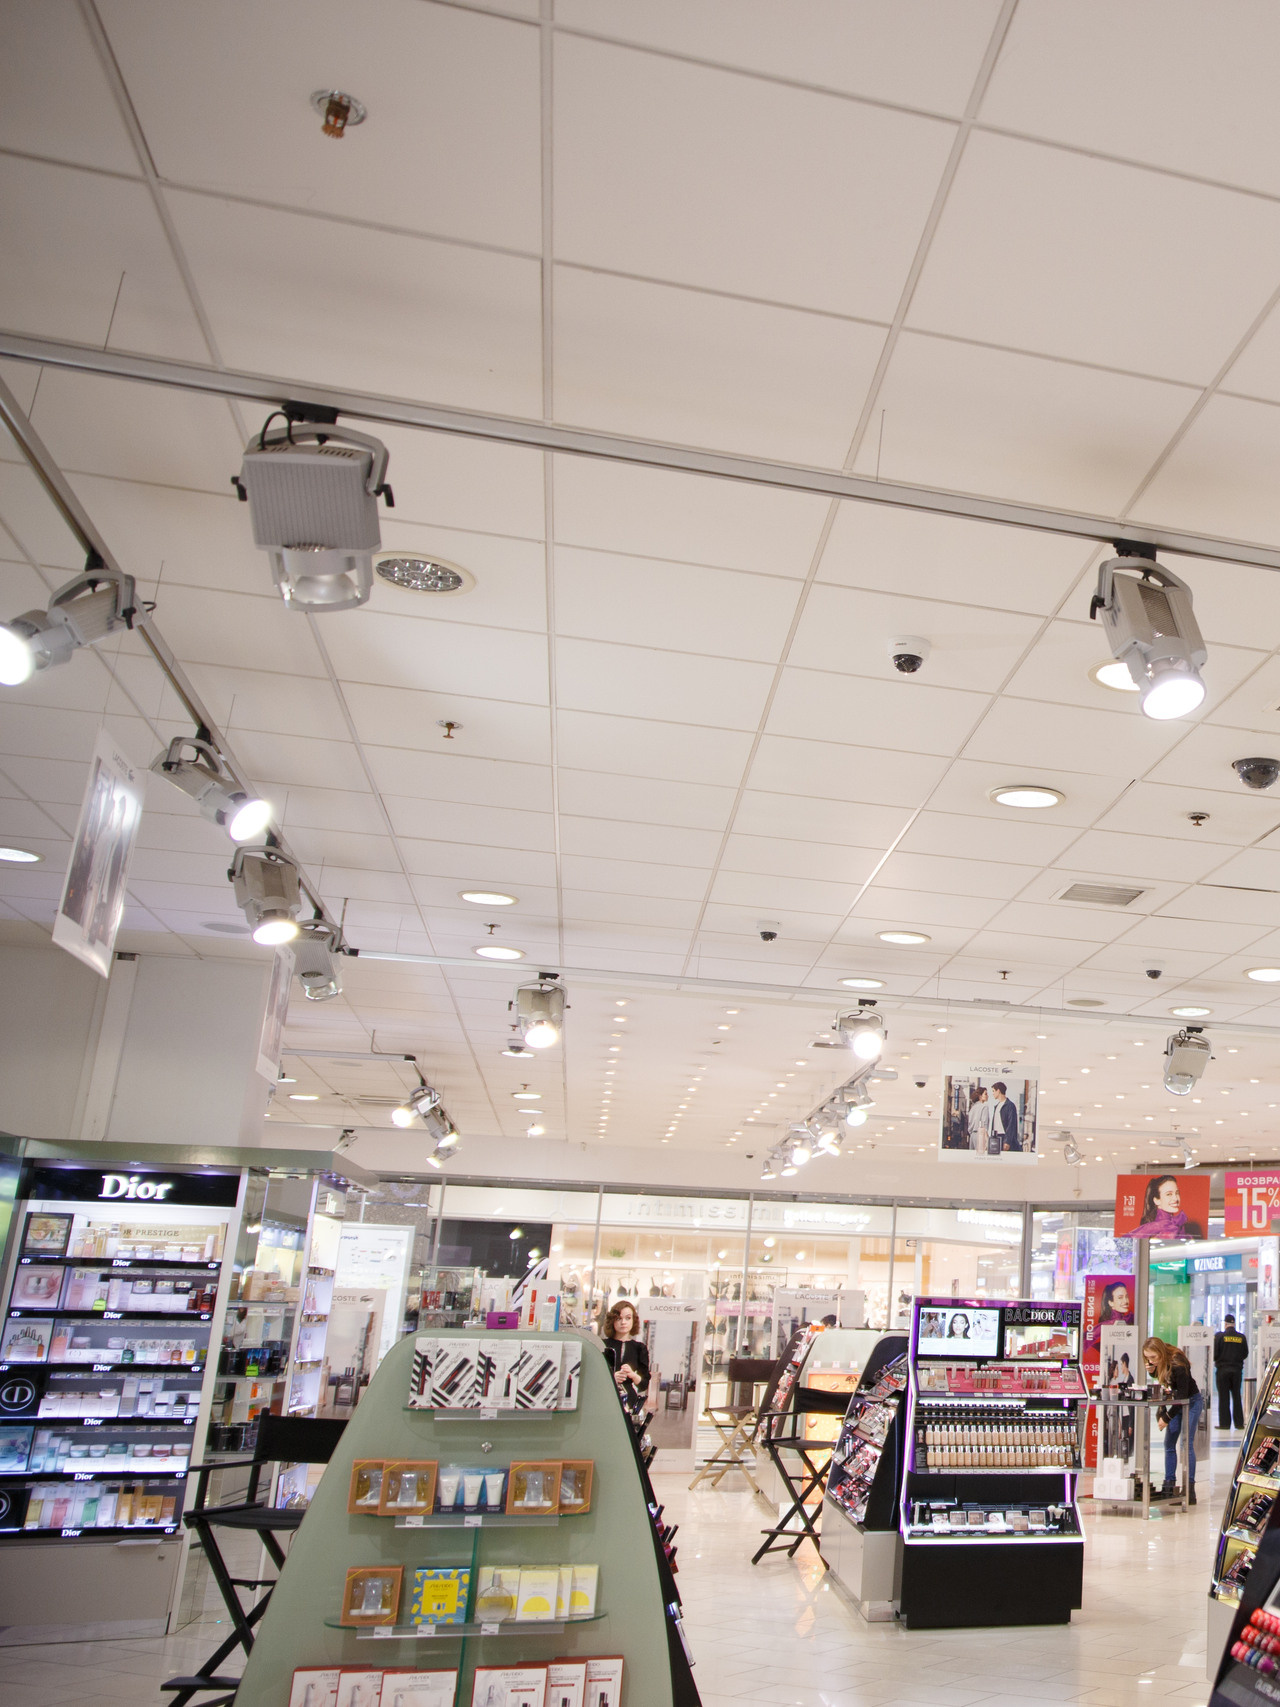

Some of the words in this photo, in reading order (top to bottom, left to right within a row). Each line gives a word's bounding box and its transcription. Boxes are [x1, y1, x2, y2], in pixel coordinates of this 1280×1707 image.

[98, 1174, 173, 1200] Dior
[1237, 1187, 1280, 1229] 15%
[135, 1229, 180, 1237] PRESTIGE
[112, 1259, 131, 1267] Dior
[1198, 1256, 1224, 1271] ZINGER
[795, 1293, 830, 1301] LACOSTE
[1086, 1296, 1095, 1317] РИВ
[1030, 1311, 1056, 1322] DIOR
[1086, 1318, 1094, 1341] ГОШ
[93, 1364, 112, 1372] Dior
[61, 1529, 82, 1537] Dior
